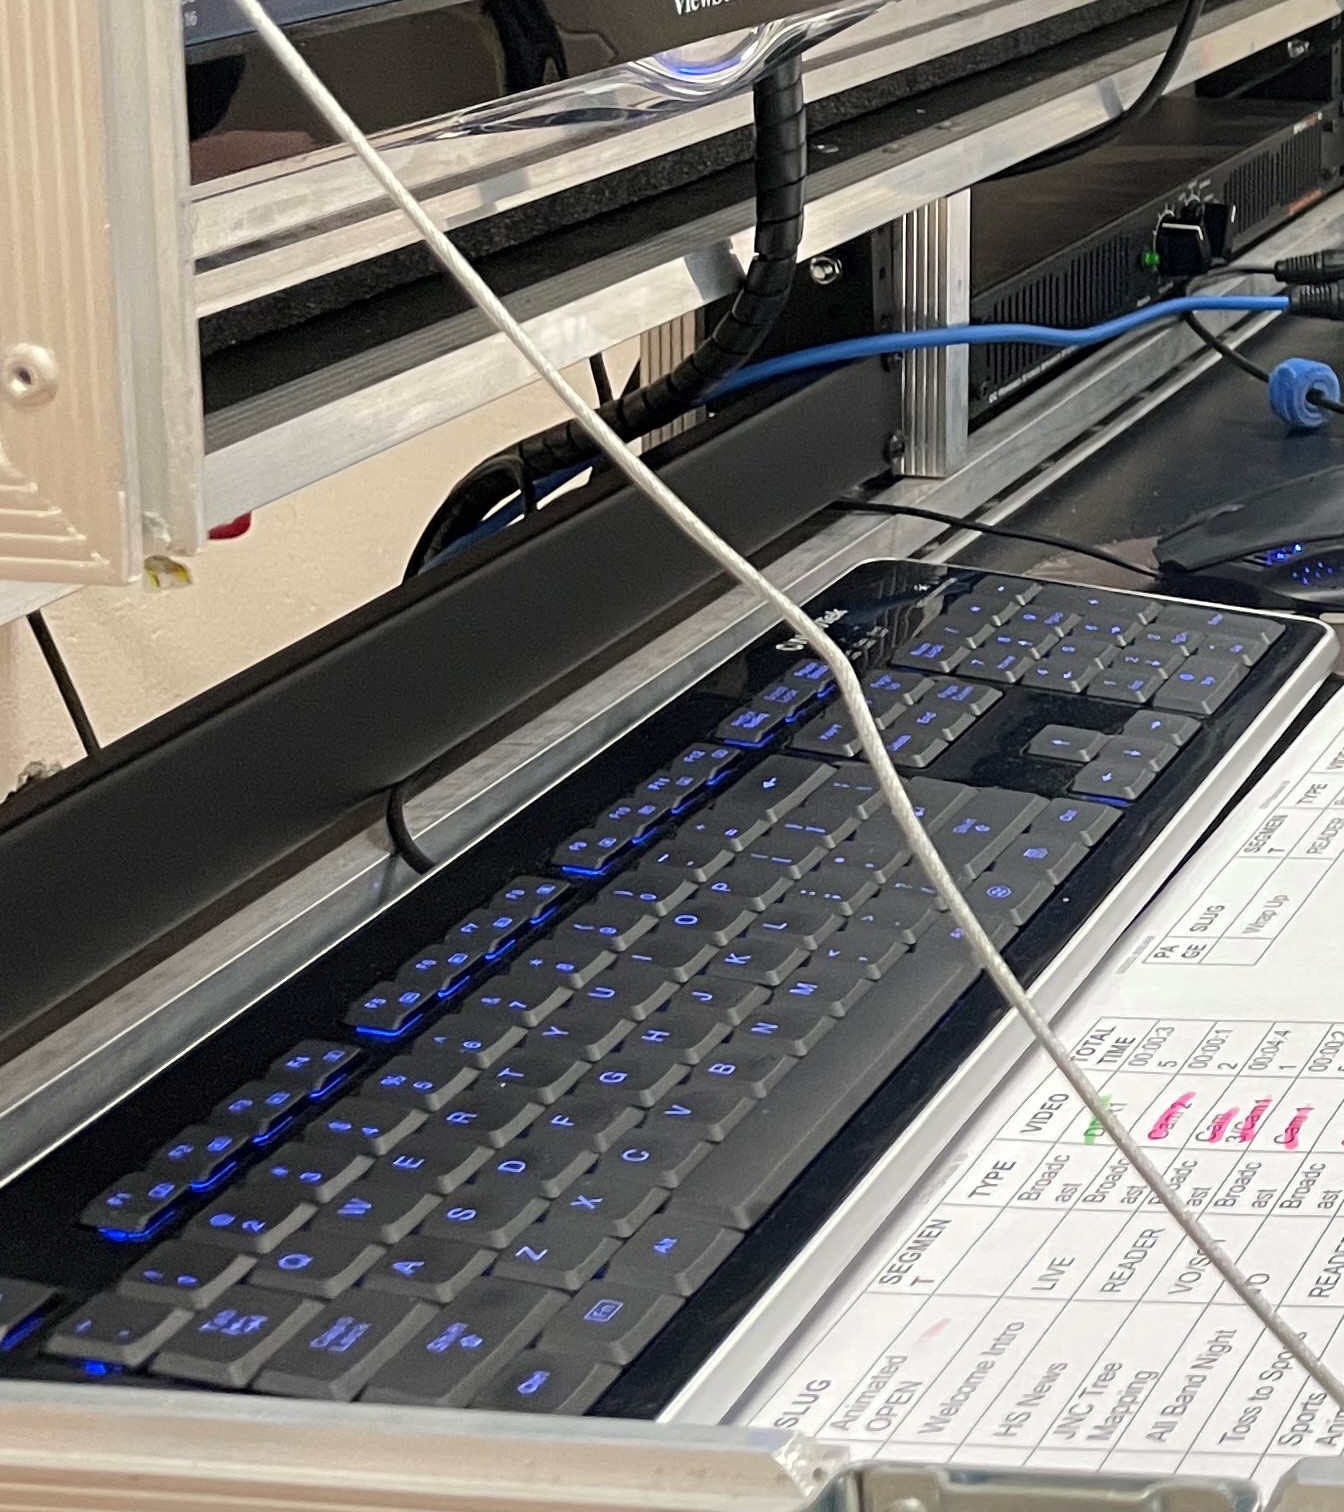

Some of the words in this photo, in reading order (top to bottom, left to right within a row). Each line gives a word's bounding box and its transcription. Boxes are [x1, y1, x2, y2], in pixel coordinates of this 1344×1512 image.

[1296, 782, 1328, 805] TYPE
[1243, 814, 1288, 854] SEGMEN
[711, 882, 731, 893] P
[674, 914, 698, 926] O
[1189, 904, 1226, 933] SLUG
[1241, 909, 1277, 935] Wrap
[1264, 894, 1290, 910] Up
[1152, 944, 1179, 959] PA
[1181, 943, 1207, 959] GE
[542, 1026, 569, 1036] Y
[641, 1029, 670, 1042] H
[751, 1022, 778, 1034] N
[1070, 1026, 1117, 1062] TOTAL
[1096, 1037, 1136, 1065] TIME
[497, 1067, 525, 1079] T
[708, 1062, 736, 1075] B
[1158, 1060, 1178, 1068] 5
[1217, 1062, 1238, 1070] 2
[599, 1071, 628, 1083] G
[446, 1111, 478, 1124] R
[550, 1114, 575, 1127] F
[664, 1104, 692, 1117] V
[1020, 1093, 1070, 1134] VIDEO
[393, 1155, 426, 1169] E
[622, 1148, 650, 1162] C
[497, 1160, 526, 1173] D
[968, 1160, 1017, 1199] TYPE
[1017, 1154, 1070, 1202] Broadc
[1214, 1161, 1262, 1207] Broadc
[1279, 1162, 1326, 1209] Broadc
[569, 1194, 603, 1209] X
[1055, 1182, 1082, 1203] ast
[1251, 1188, 1277, 1208] ast
[1317, 1189, 1343, 1209] ast
[446, 1207, 477, 1221] S
[277, 1252, 313, 1271] Q
[515, 1245, 549, 1261] Z
[878, 1218, 952, 1285] SEGMEN
[1100, 1228, 1165, 1294] READER
[392, 1259, 425, 1276] A
[1031, 1256, 1076, 1291] LIVE
[910, 1276, 935, 1286] T
[1191, 1328, 1238, 1370] Night
[917, 1359, 995, 1435] Welcome
[980, 1321, 1025, 1358] Intro
[773, 1378, 832, 1429] SLUG
[830, 1355, 908, 1432] Animated
[993, 1411, 1031, 1438] HS
[1015, 1361, 1069, 1408] News
[1160, 1372, 1208, 1416] Band
[864, 1380, 923, 1432] OPEN
[1086, 1370, 1160, 1441] Mapping
[1217, 1405, 1262, 1445] Toss
[1247, 1384, 1275, 1403] to
[1278, 1391, 1328, 1447] Sports
[1146, 1420, 1176, 1443] All
